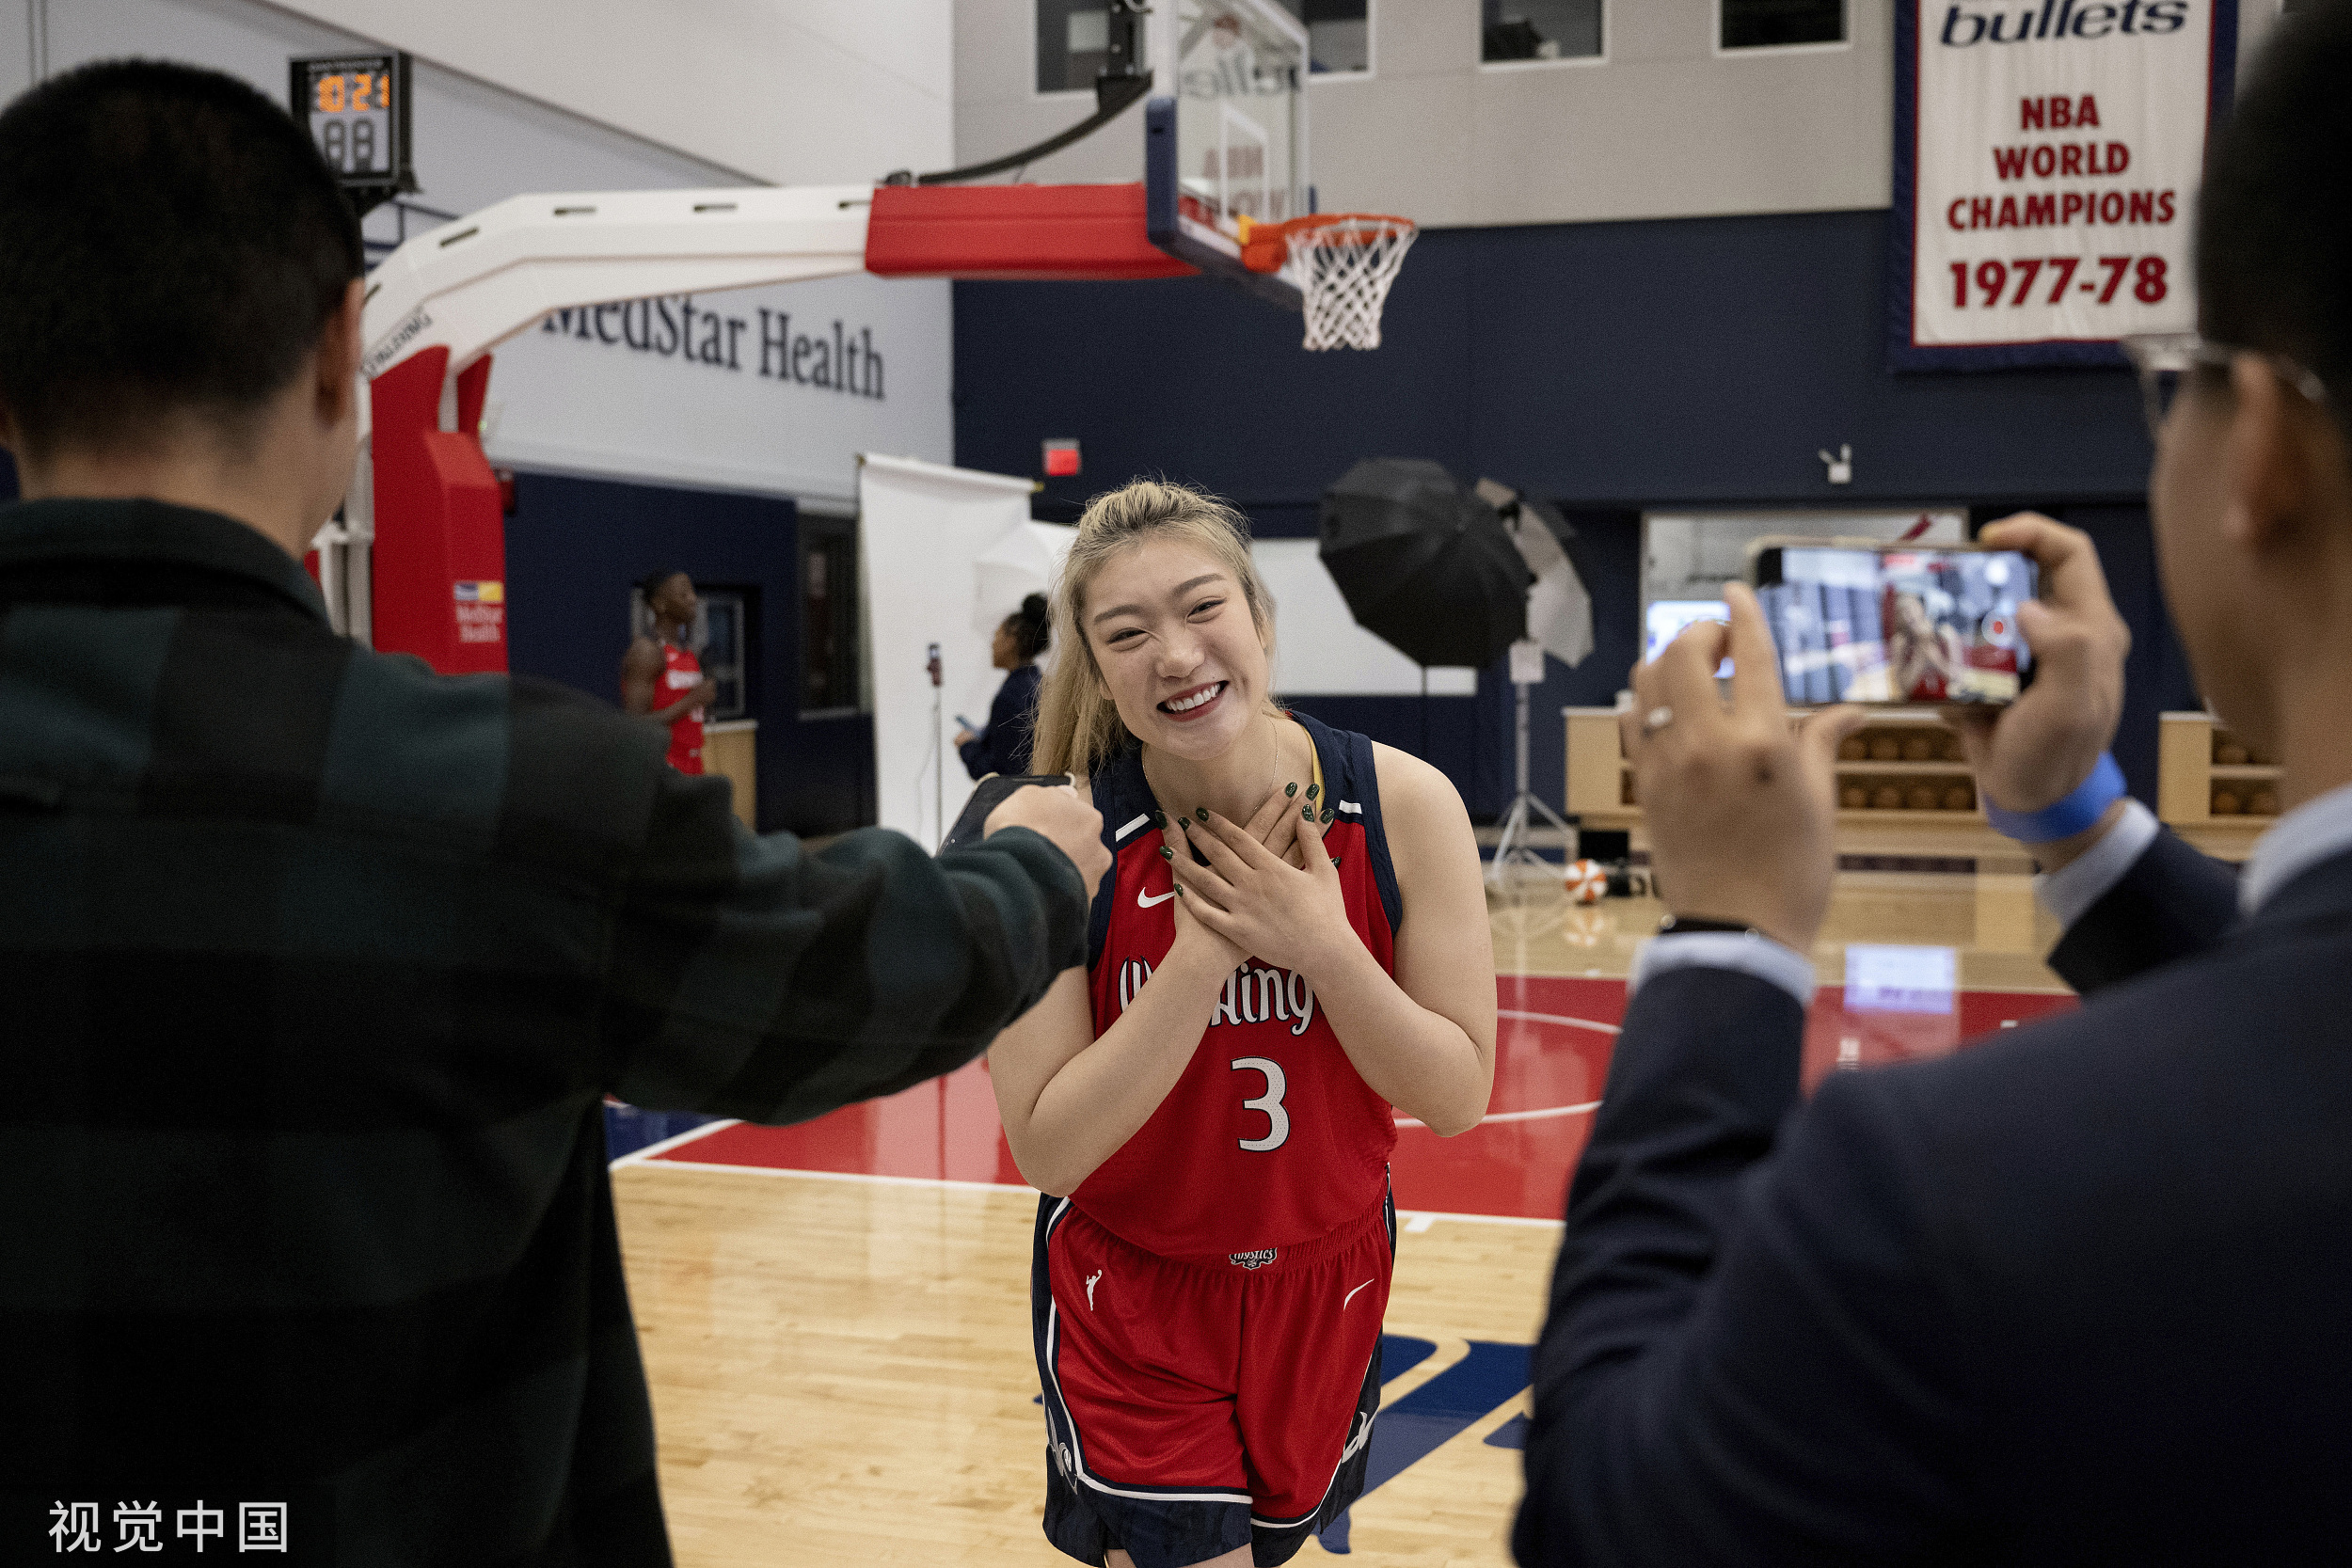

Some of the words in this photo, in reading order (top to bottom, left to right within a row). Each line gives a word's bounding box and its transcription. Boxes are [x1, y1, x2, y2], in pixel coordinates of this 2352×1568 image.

[1940, 0, 2190, 47] bullets
[2020, 94, 2100, 131] NBA
[1994, 141, 2130, 181] WORLD
[1947, 189, 2176, 231] CHAMPIONS
[1949, 255, 2169, 309] 1977-78
[756, 307, 885, 402] Health
[1230, 1055, 1291, 1153] 3
